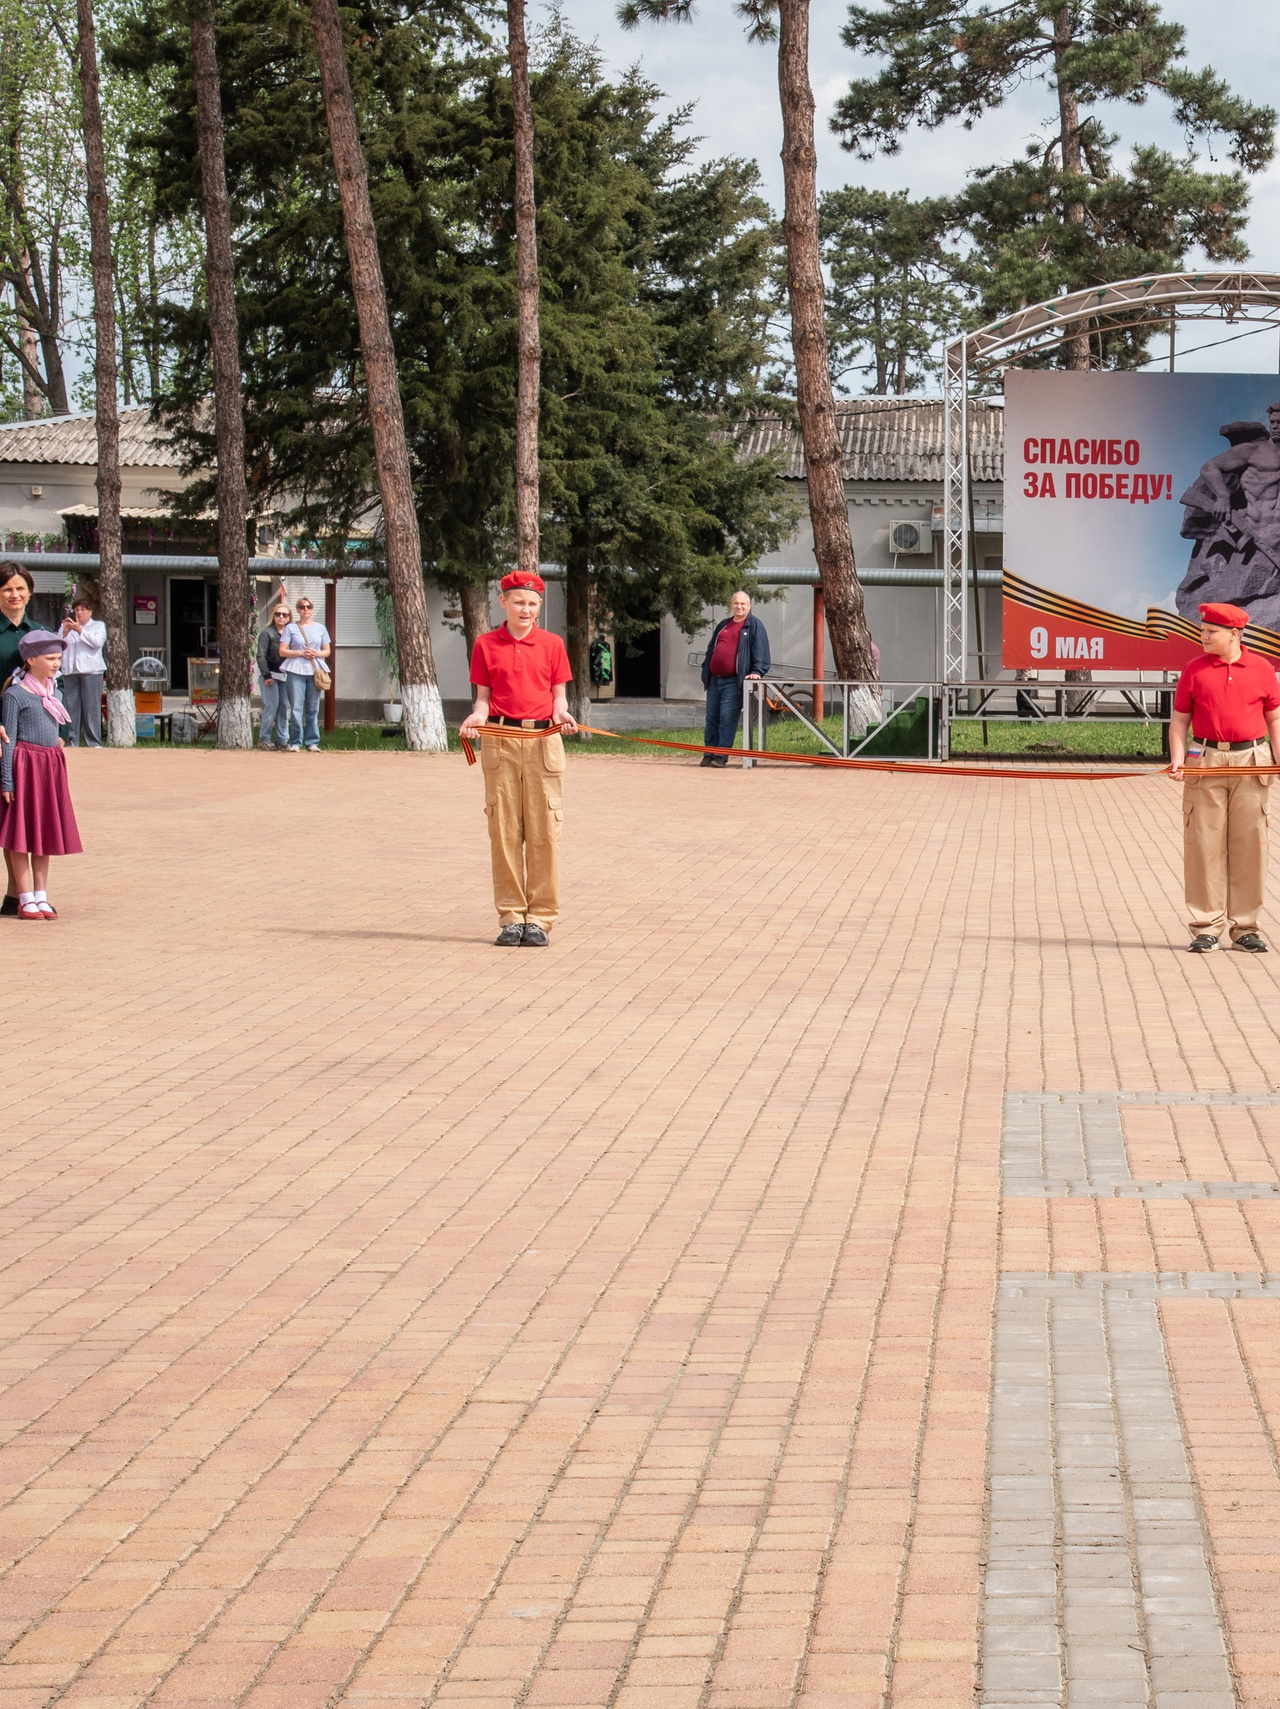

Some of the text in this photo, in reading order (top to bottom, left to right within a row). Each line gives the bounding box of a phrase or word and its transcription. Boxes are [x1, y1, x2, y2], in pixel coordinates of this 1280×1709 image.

[1023, 437, 1140, 466] СПАСИБО
[1023, 472, 1173, 504] ЗА ПОБЕДУ!
[1030, 626, 1104, 660] 9 МАЯ
